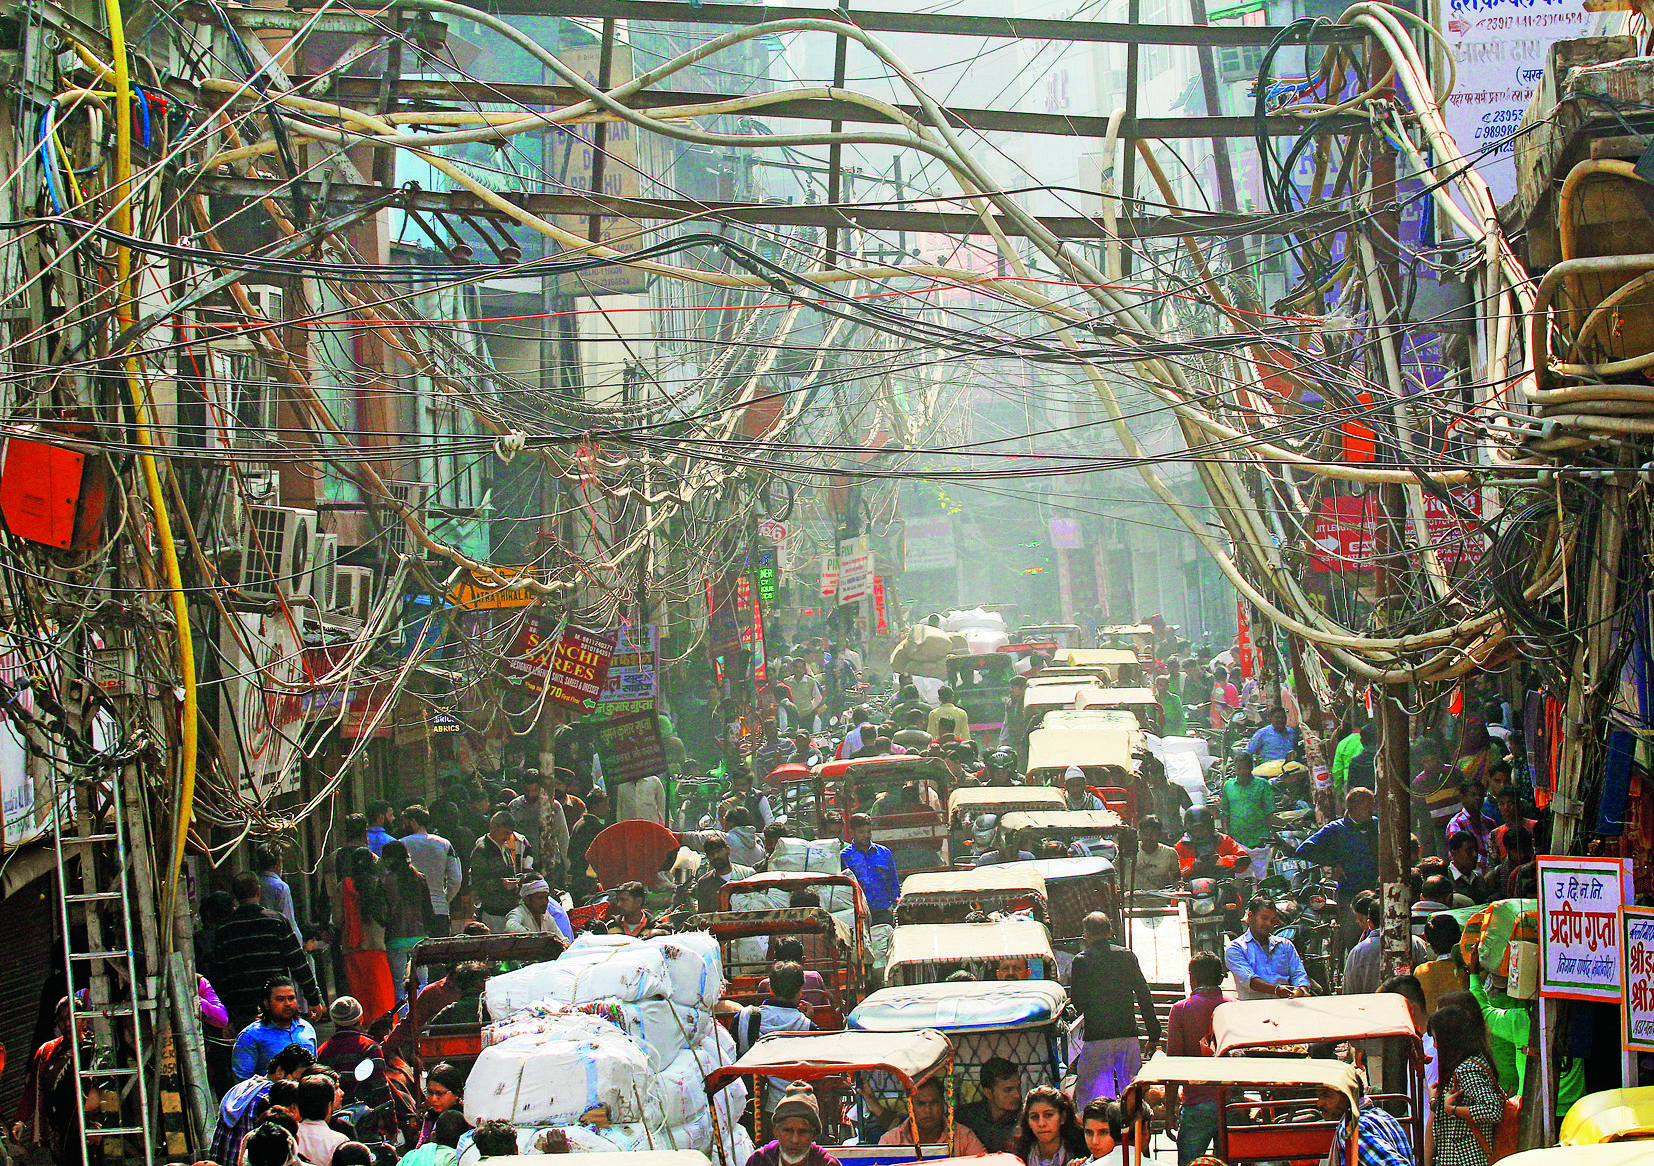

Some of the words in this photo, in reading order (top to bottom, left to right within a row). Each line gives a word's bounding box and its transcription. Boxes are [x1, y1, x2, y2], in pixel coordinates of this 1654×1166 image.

[525, 648, 595, 681] SAREES
[1549, 900, 1583, 948] प्रदीप
[1584, 911, 1616, 952] गुप्ता
